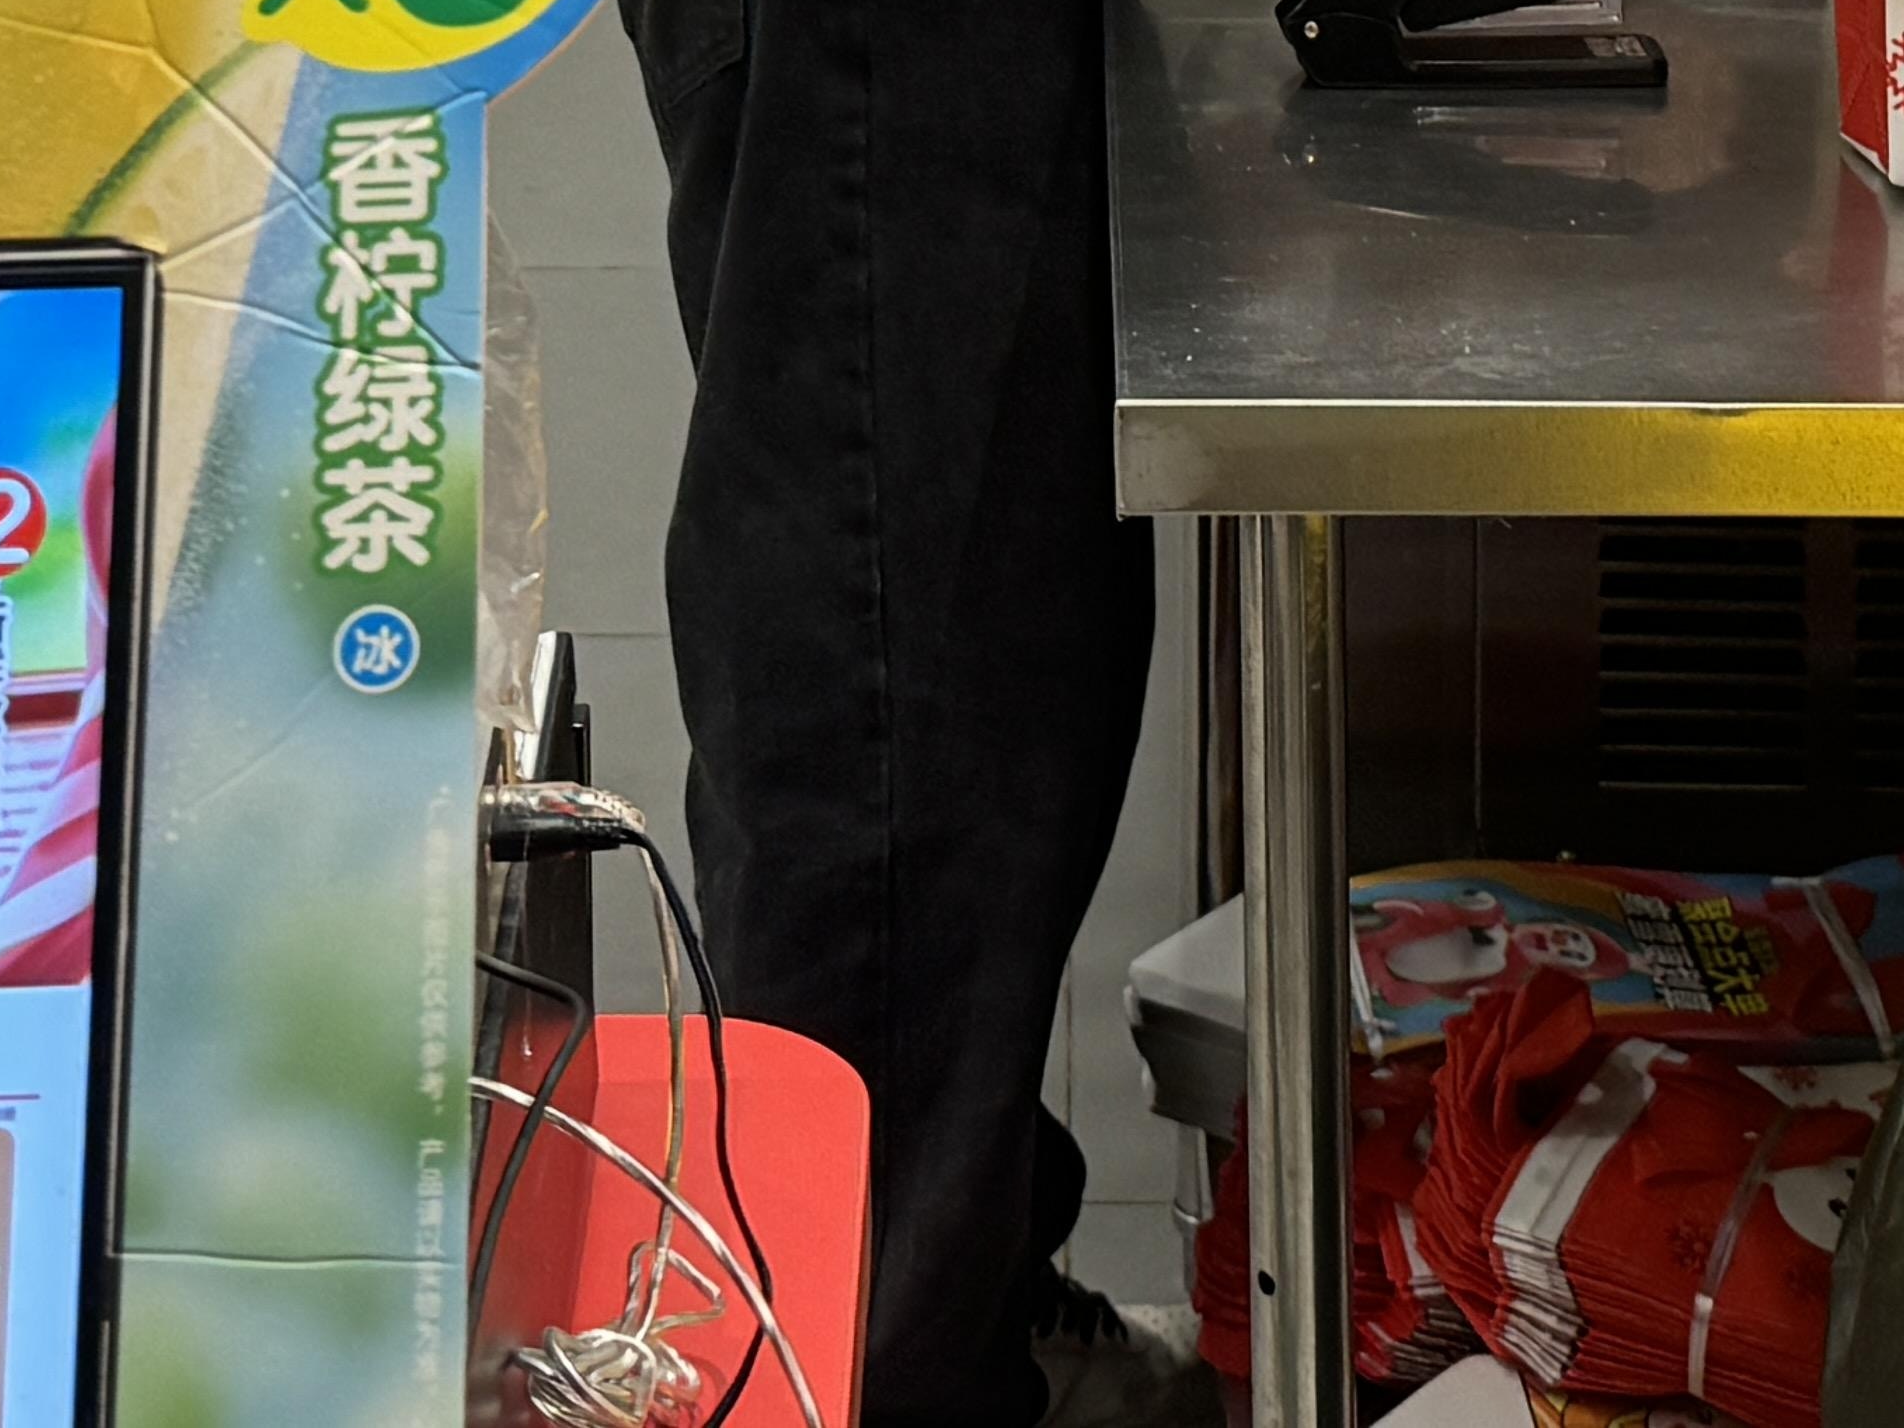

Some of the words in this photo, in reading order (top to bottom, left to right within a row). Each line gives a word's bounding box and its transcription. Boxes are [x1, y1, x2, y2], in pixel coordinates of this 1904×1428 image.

[320, 117, 441, 574] 香柠绿茶
[354, 628, 405, 676] 冰
